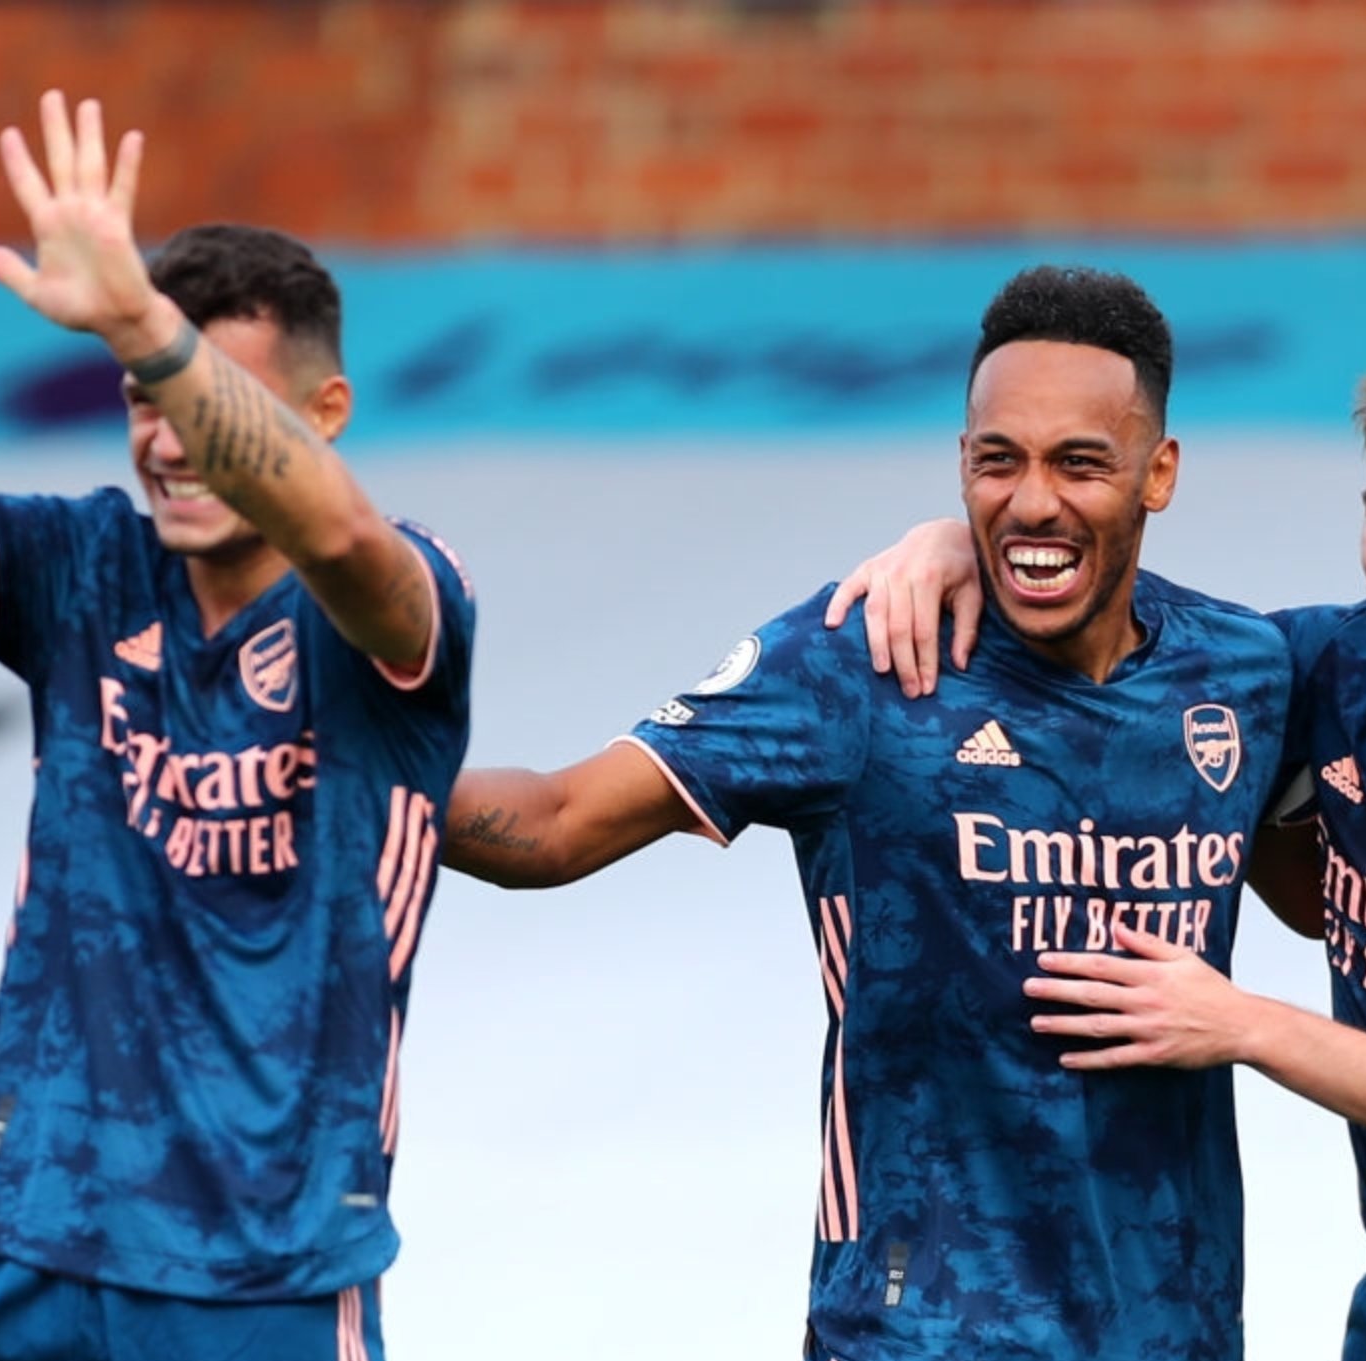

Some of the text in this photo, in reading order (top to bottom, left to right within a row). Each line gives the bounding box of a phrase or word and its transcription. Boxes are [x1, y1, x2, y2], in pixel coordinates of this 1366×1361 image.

[956, 748, 1021, 767] adidas
[952, 812, 1245, 890] Emirates
[1010, 896, 1073, 952] FLY
